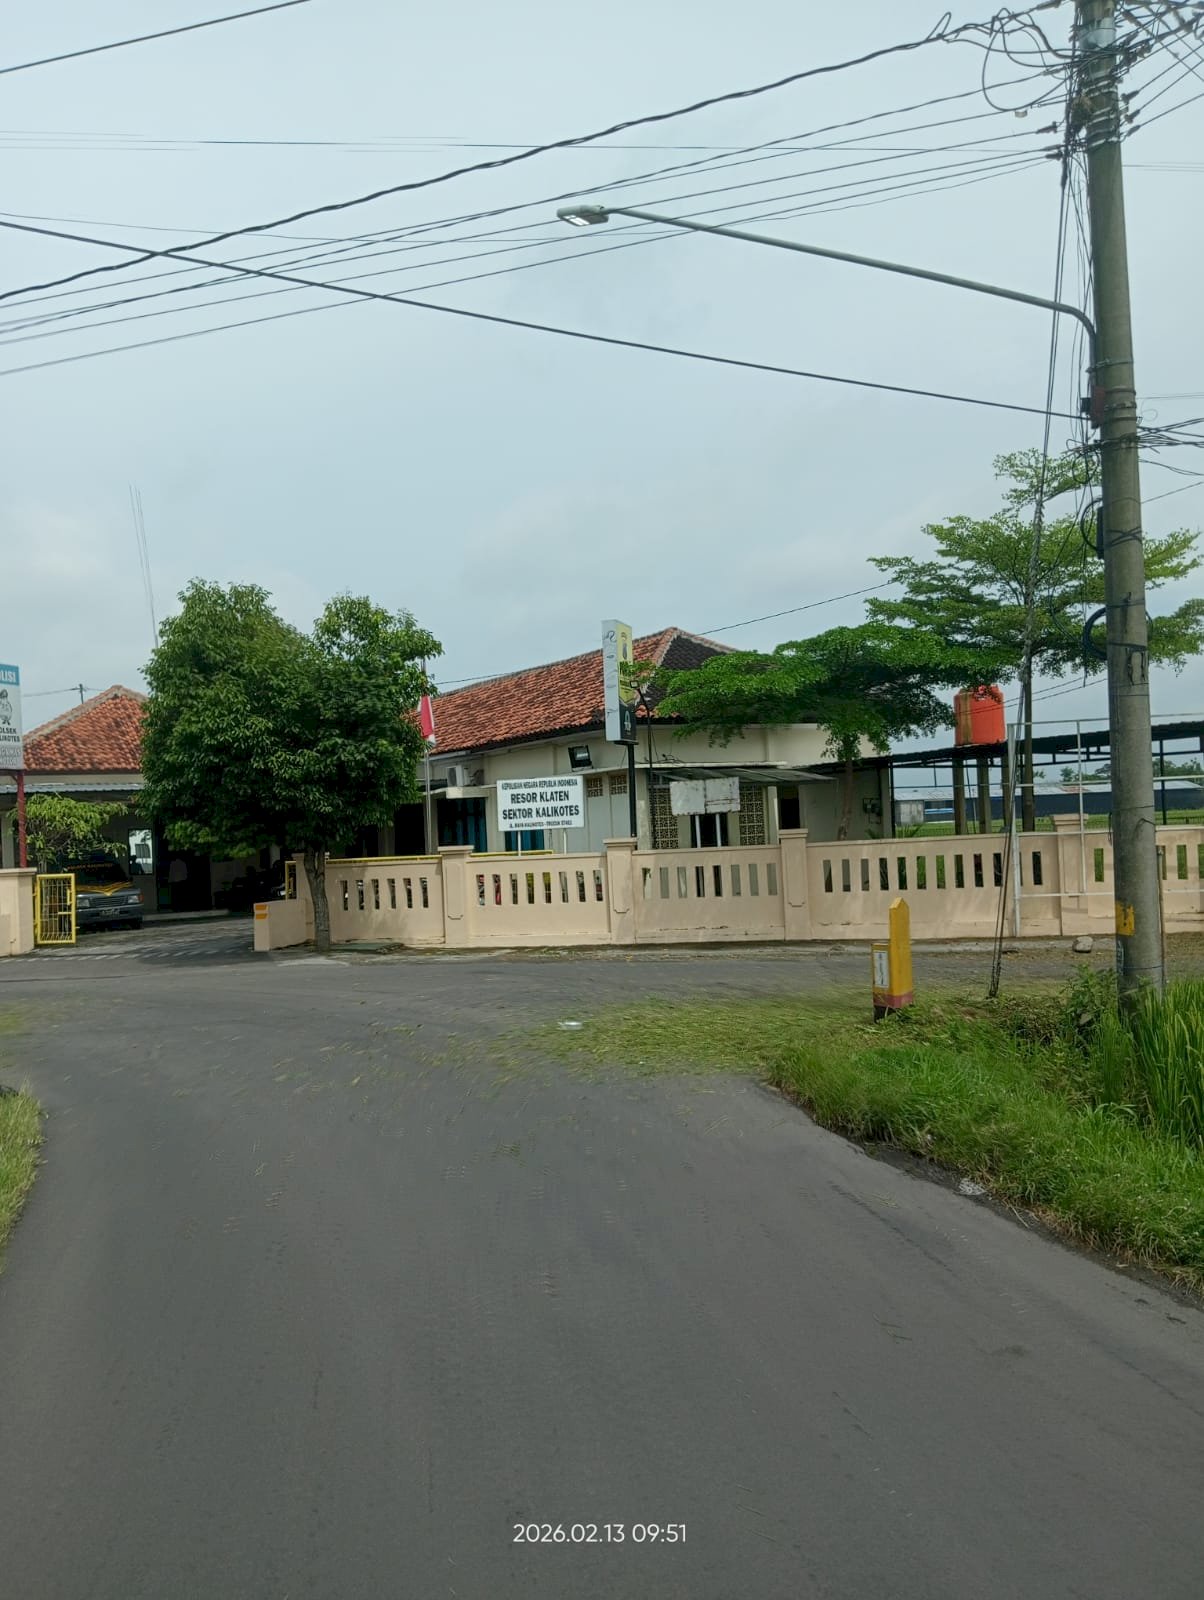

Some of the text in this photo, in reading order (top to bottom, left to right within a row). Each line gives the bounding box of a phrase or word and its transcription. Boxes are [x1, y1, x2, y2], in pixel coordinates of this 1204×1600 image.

[0, 669, 16, 683] LISI
[511, 791, 569, 804] RESOR KLATEN
[502, 805, 580, 820] SEKTOR KALIKOTES
